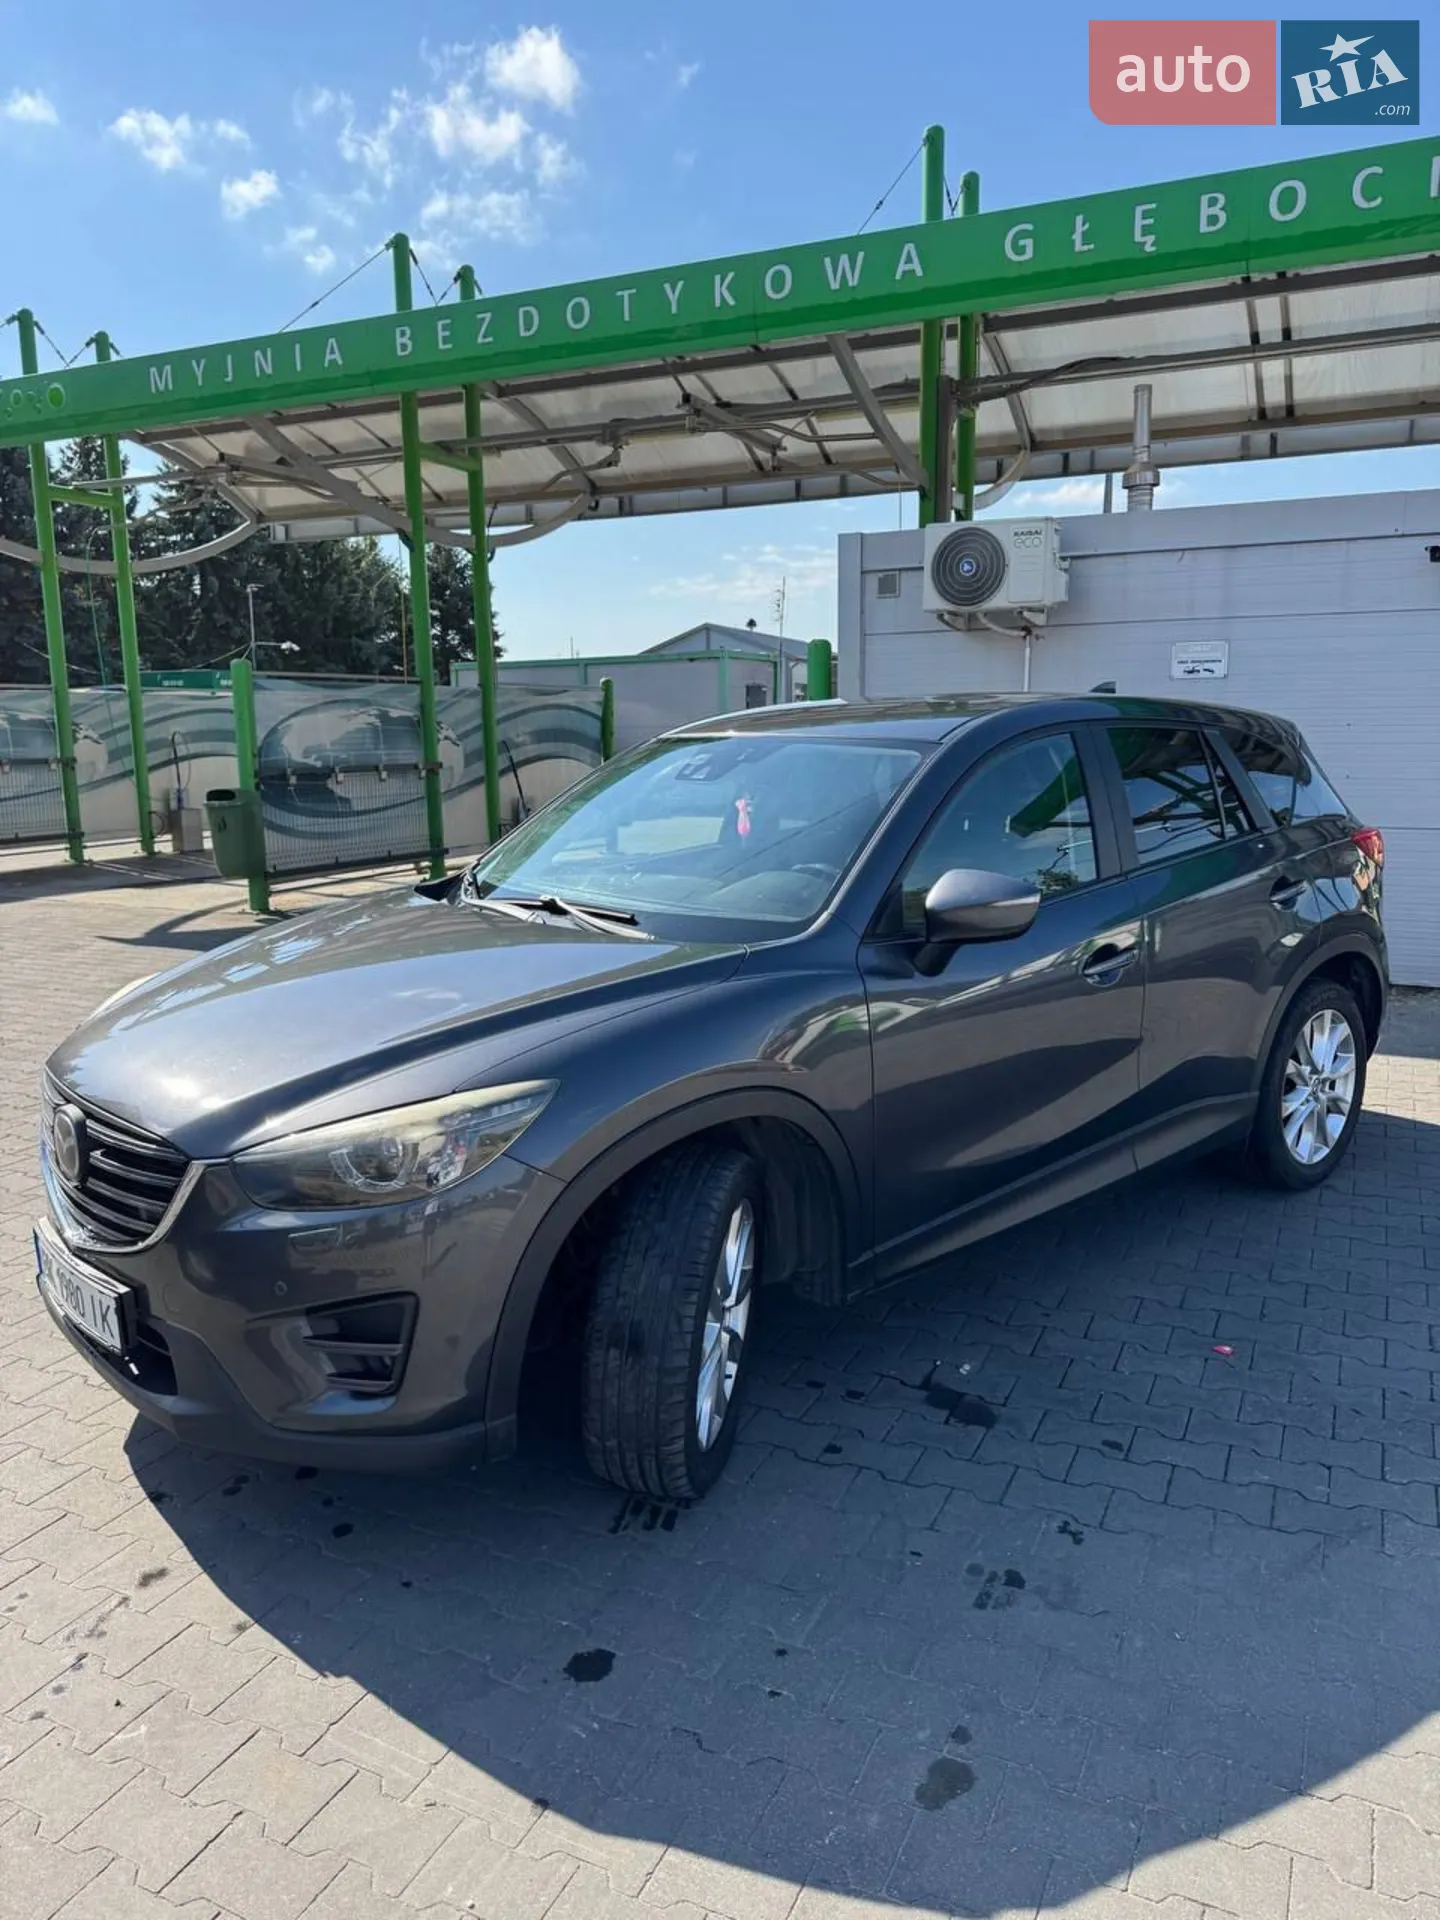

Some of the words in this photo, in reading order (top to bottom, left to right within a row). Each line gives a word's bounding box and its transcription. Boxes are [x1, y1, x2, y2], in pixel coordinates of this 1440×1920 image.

[149, 337, 343, 394] MYJNIA
[395, 242, 923, 357] BEZDOTYKOWA
[1004, 155, 1440, 262] GŁĘBOC
[1013, 537, 1042, 548] eco
